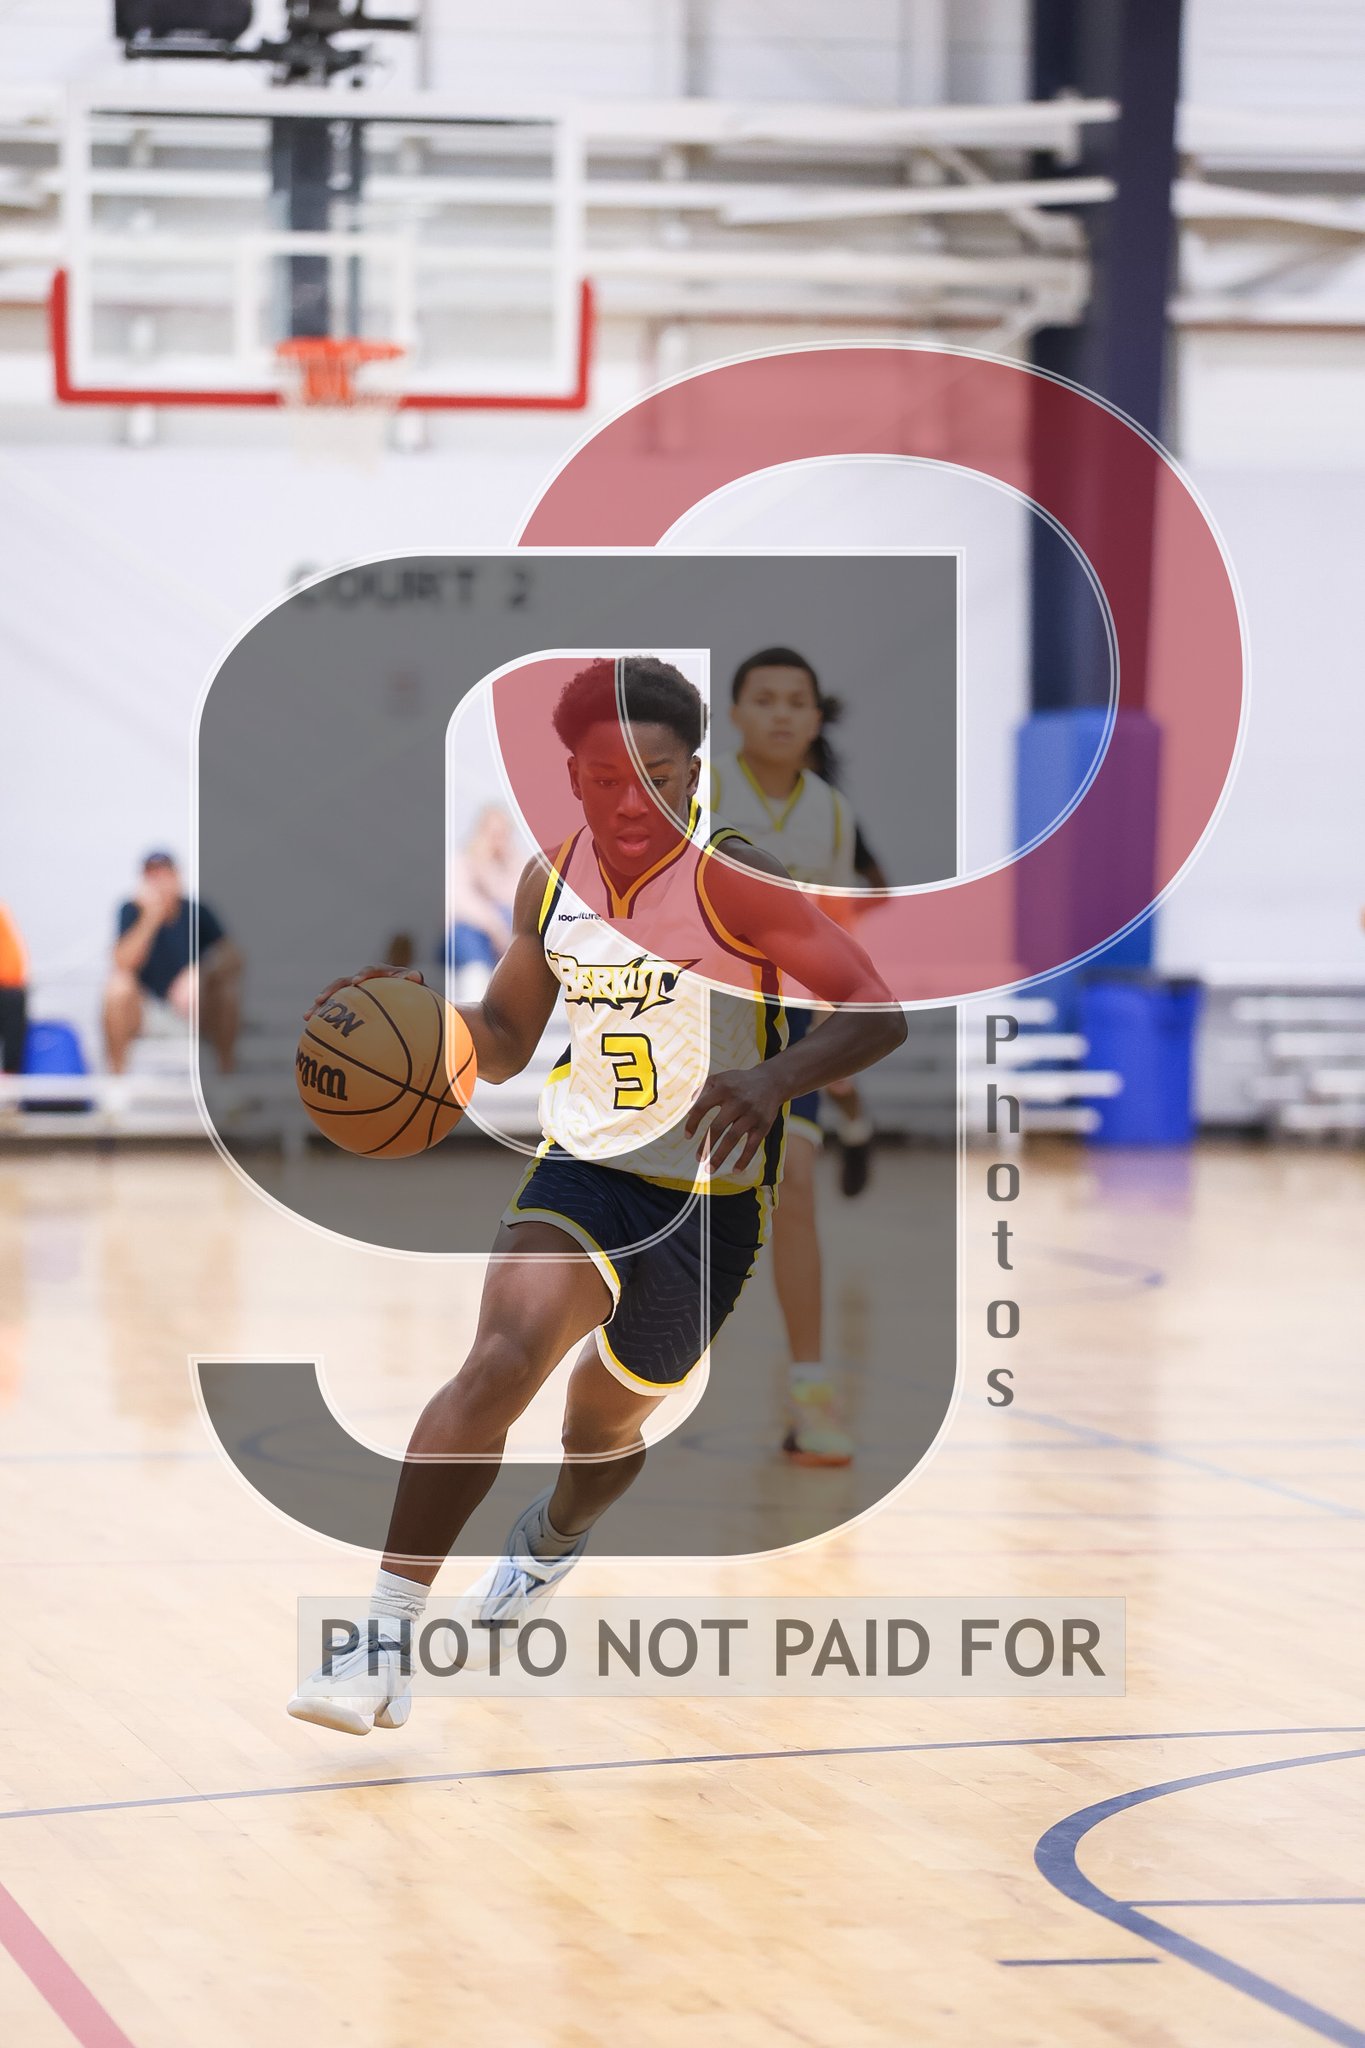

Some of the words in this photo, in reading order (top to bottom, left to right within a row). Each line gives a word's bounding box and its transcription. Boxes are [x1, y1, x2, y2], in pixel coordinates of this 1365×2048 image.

[289, 563, 475, 611] COURT
[502, 566, 534, 612] 2
[550, 951, 702, 1020] BERKUT
[601, 1033, 659, 1110] 3
